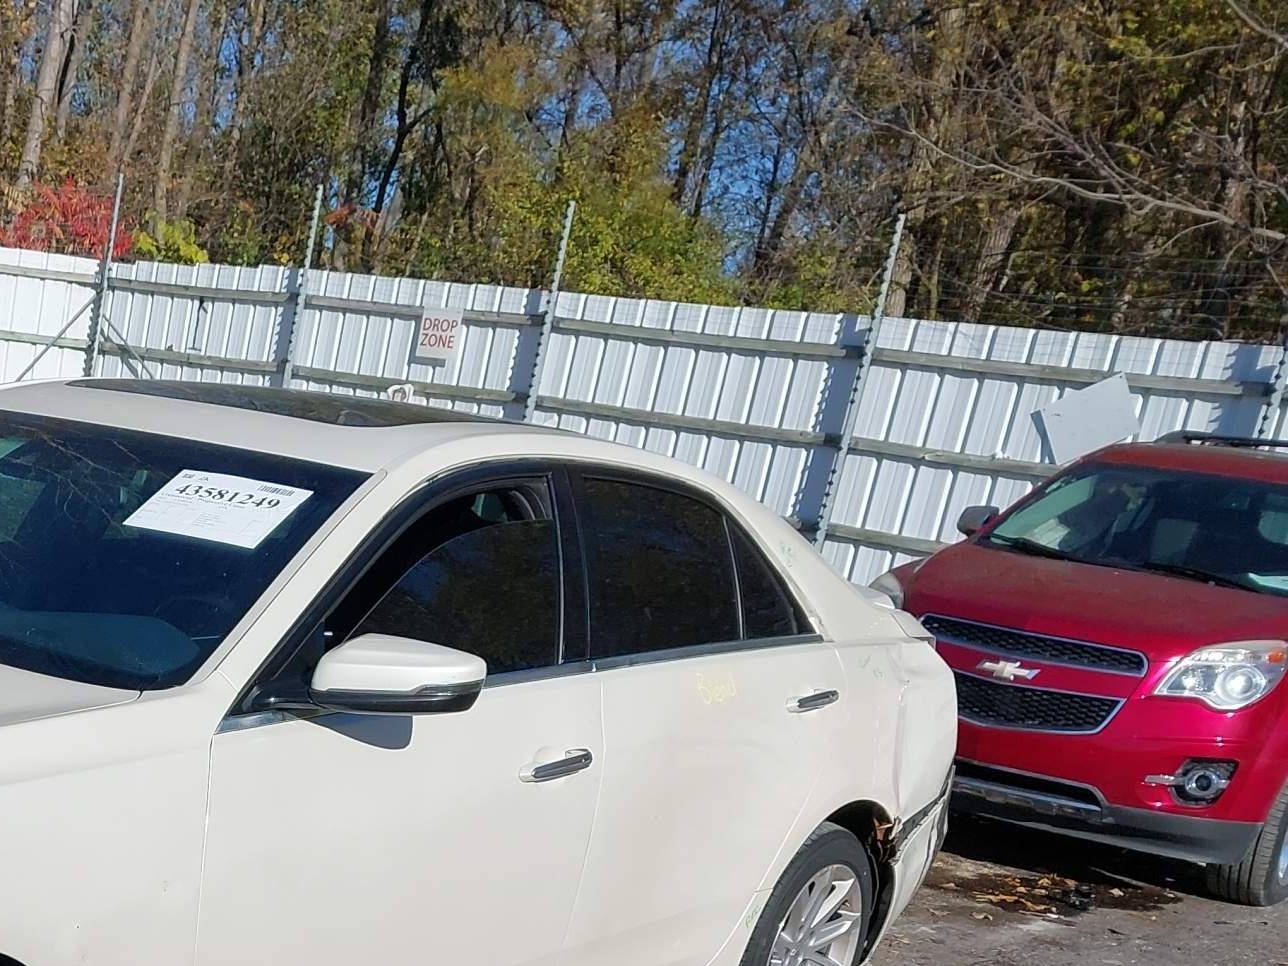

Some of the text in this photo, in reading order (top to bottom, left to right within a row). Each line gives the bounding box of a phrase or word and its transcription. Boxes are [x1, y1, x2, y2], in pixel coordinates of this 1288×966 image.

[422, 317, 459, 333] DROP
[419, 333, 456, 349] ZONE
[175, 483, 281, 509] 43581249
